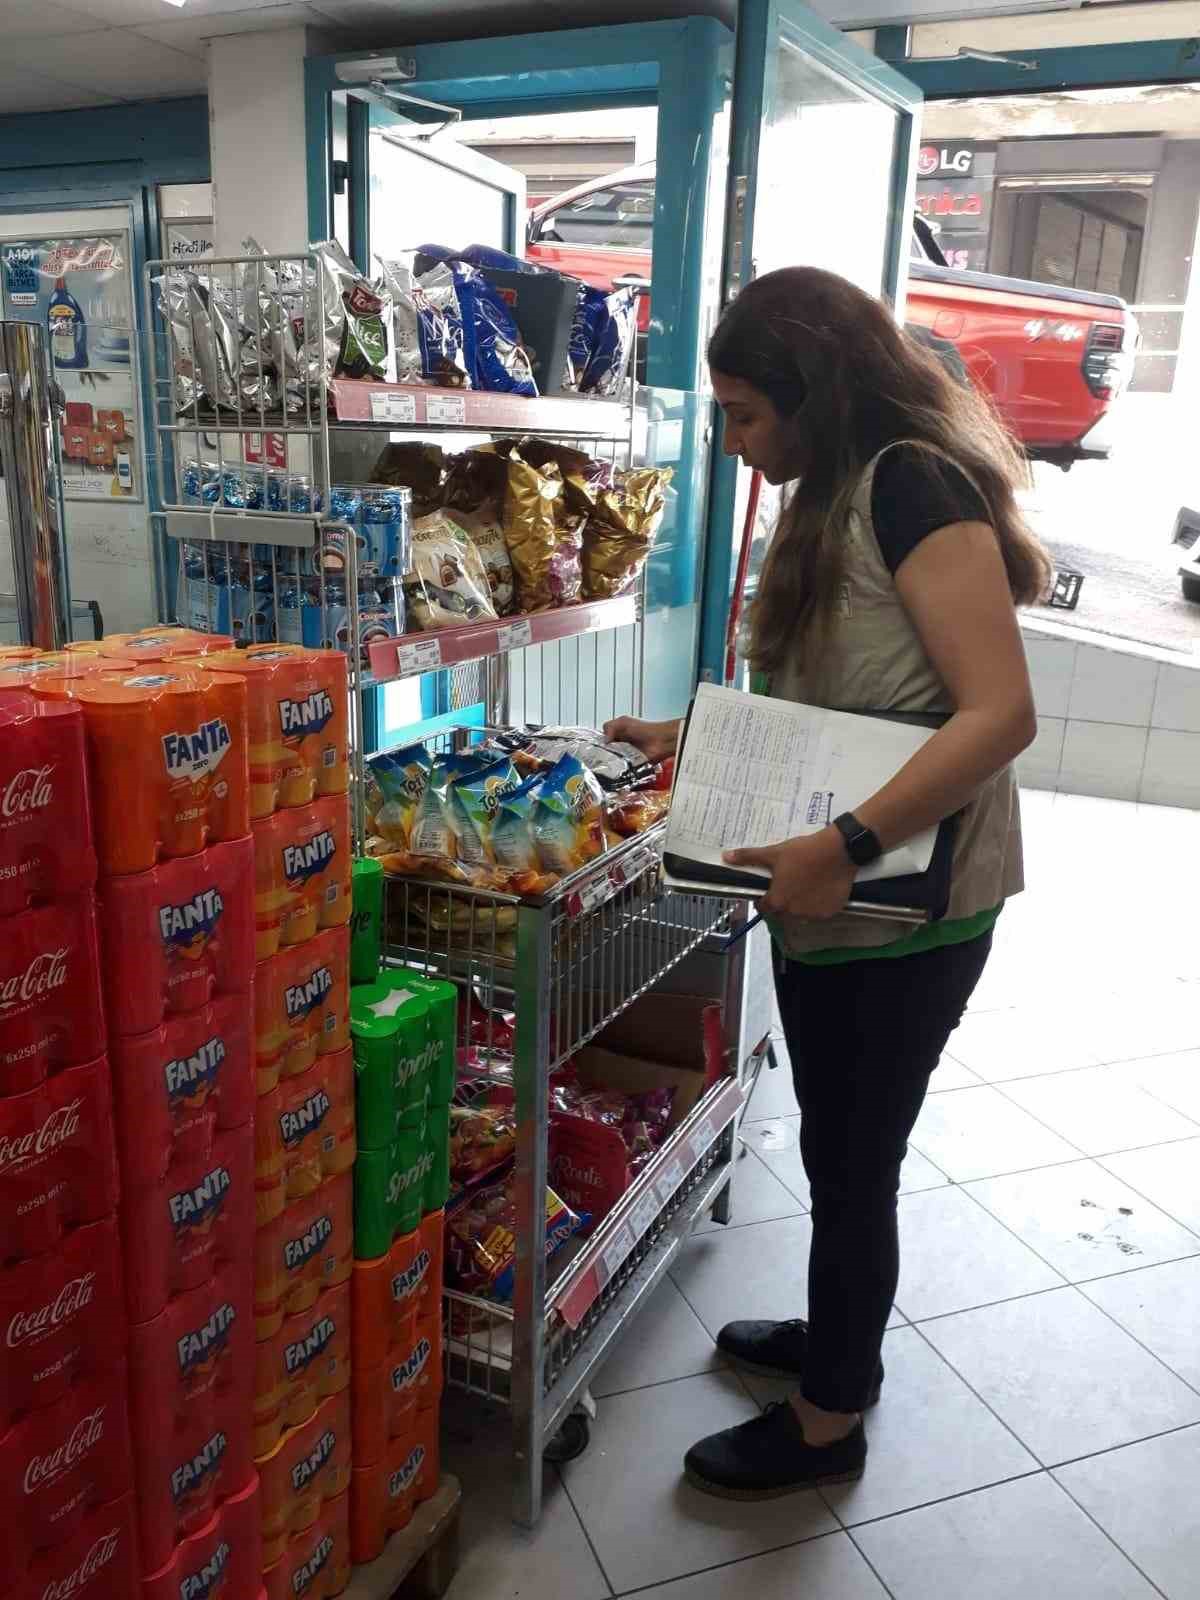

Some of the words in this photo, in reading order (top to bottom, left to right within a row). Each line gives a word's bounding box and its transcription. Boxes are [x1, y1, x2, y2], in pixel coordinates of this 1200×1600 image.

[940, 149, 972, 172] LG
[279, 690, 333, 732] FANTA
[163, 720, 230, 769] FANTA
[284, 832, 336, 875] FANTA
[160, 888, 224, 938] FANTA
[285, 967, 332, 1017] FANTA
[165, 1038, 225, 1093] FANTA
[396, 1040, 443, 1090] Sprite
[280, 1089, 330, 1142] FANTA
[169, 1167, 231, 1224] FANTA
[386, 1151, 434, 1202] Sprite
[284, 1215, 332, 1270] FANTA
[392, 1250, 430, 1298] FANTA
[177, 1302, 236, 1368] FANTA
[285, 1317, 336, 1374] FANTA
[392, 1338, 431, 1391] FANTA
[172, 1431, 227, 1497] FANTA
[291, 1432, 336, 1490] FANTA
[180, 1542, 231, 1600] FANTA
[292, 1536, 334, 1593] FANTA
